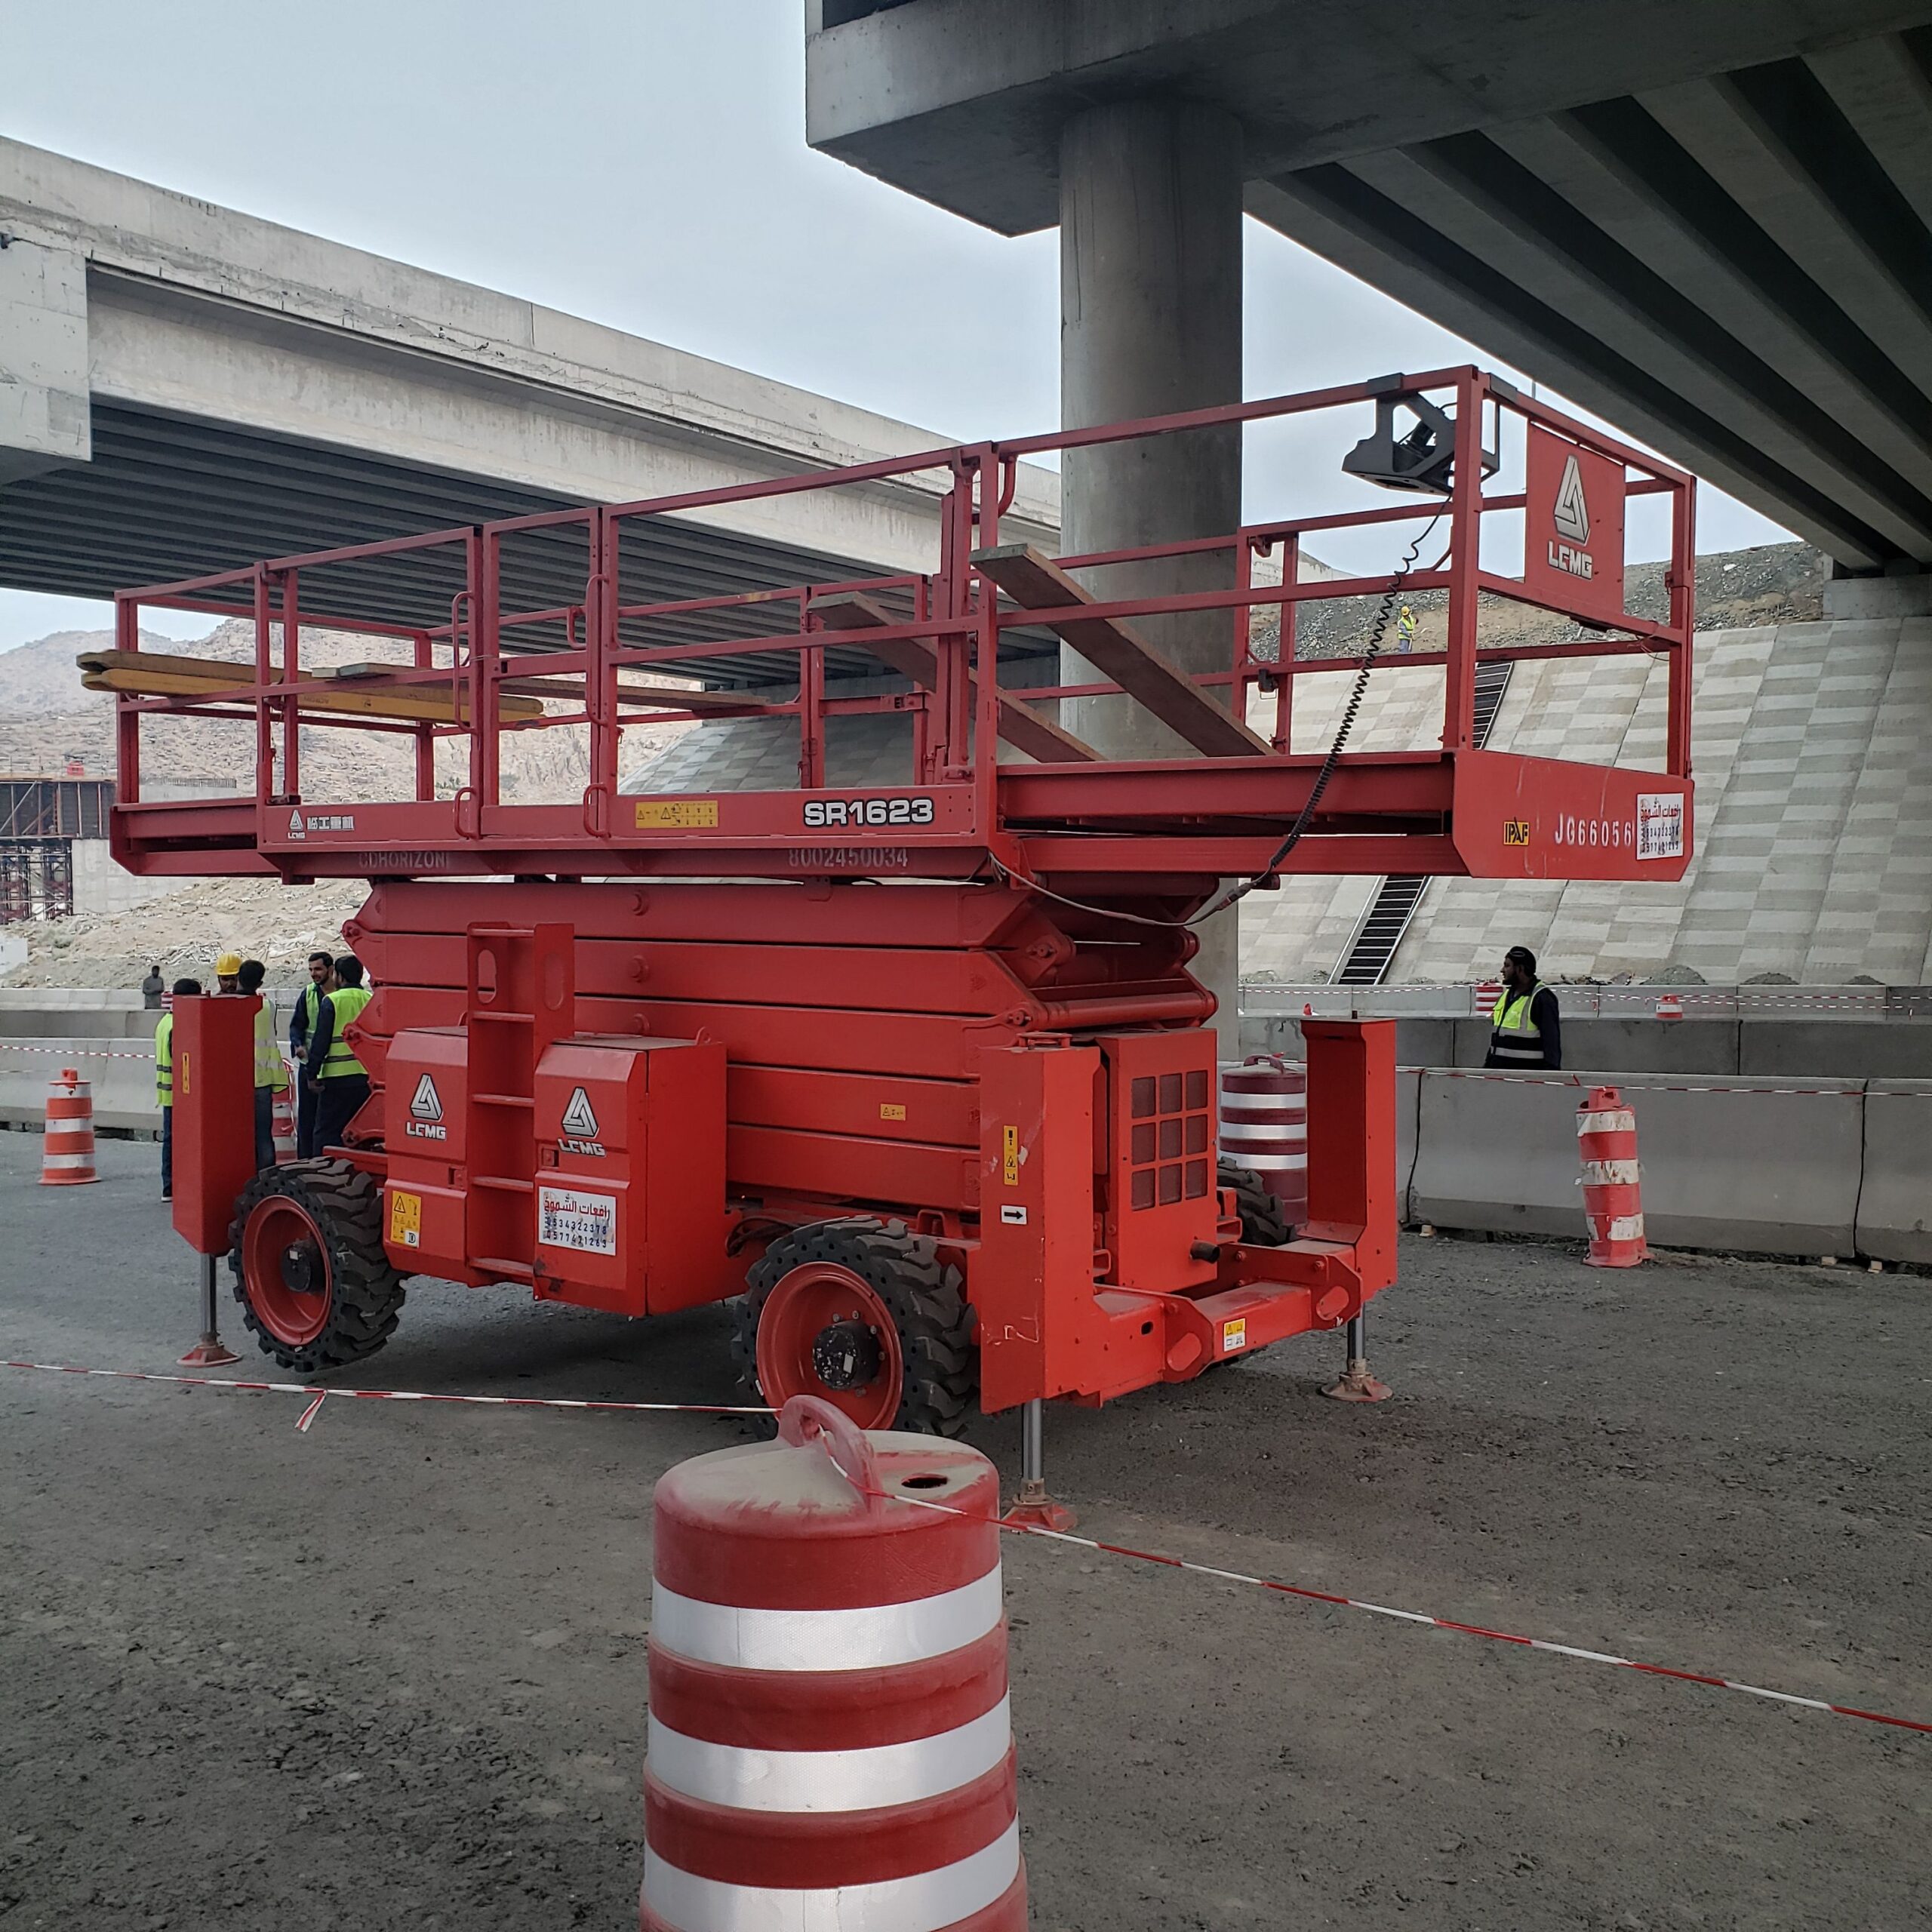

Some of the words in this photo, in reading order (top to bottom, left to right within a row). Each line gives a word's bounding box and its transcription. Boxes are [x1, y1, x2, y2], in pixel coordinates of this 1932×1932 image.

[804, 798, 934, 826] SR1623
[1505, 817, 1528, 844] IPAF
[789, 848, 908, 867] 8002450034
